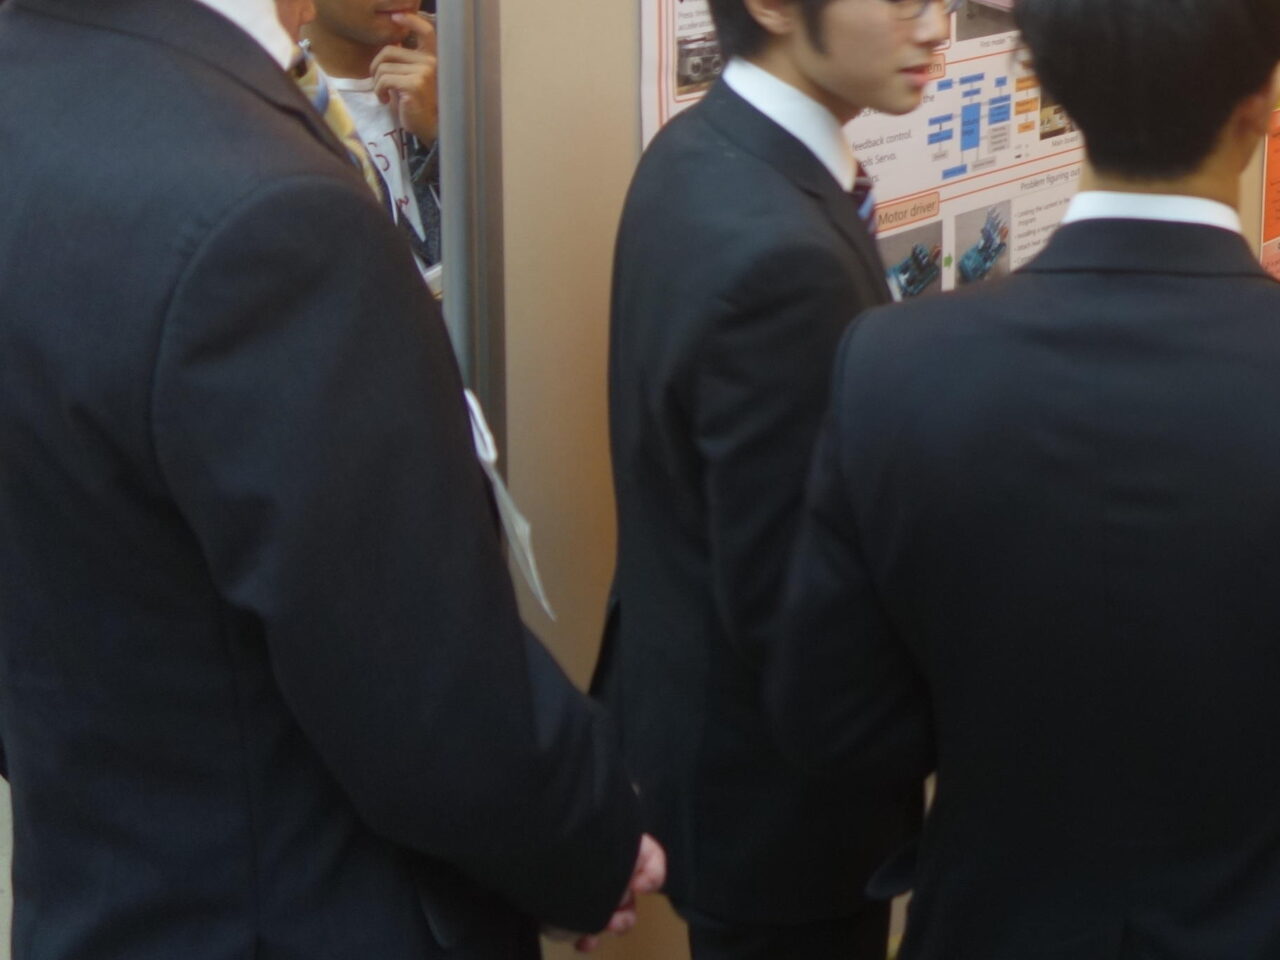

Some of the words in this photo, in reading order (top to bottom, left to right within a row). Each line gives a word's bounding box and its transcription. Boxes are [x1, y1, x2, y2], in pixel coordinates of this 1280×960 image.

[852, 136, 885, 152] feedback
[1020, 178, 1045, 191] Problem
[1046, 171, 1069, 186] figuring
[878, 209, 907, 226] Motor
[910, 200, 936, 217] driver
